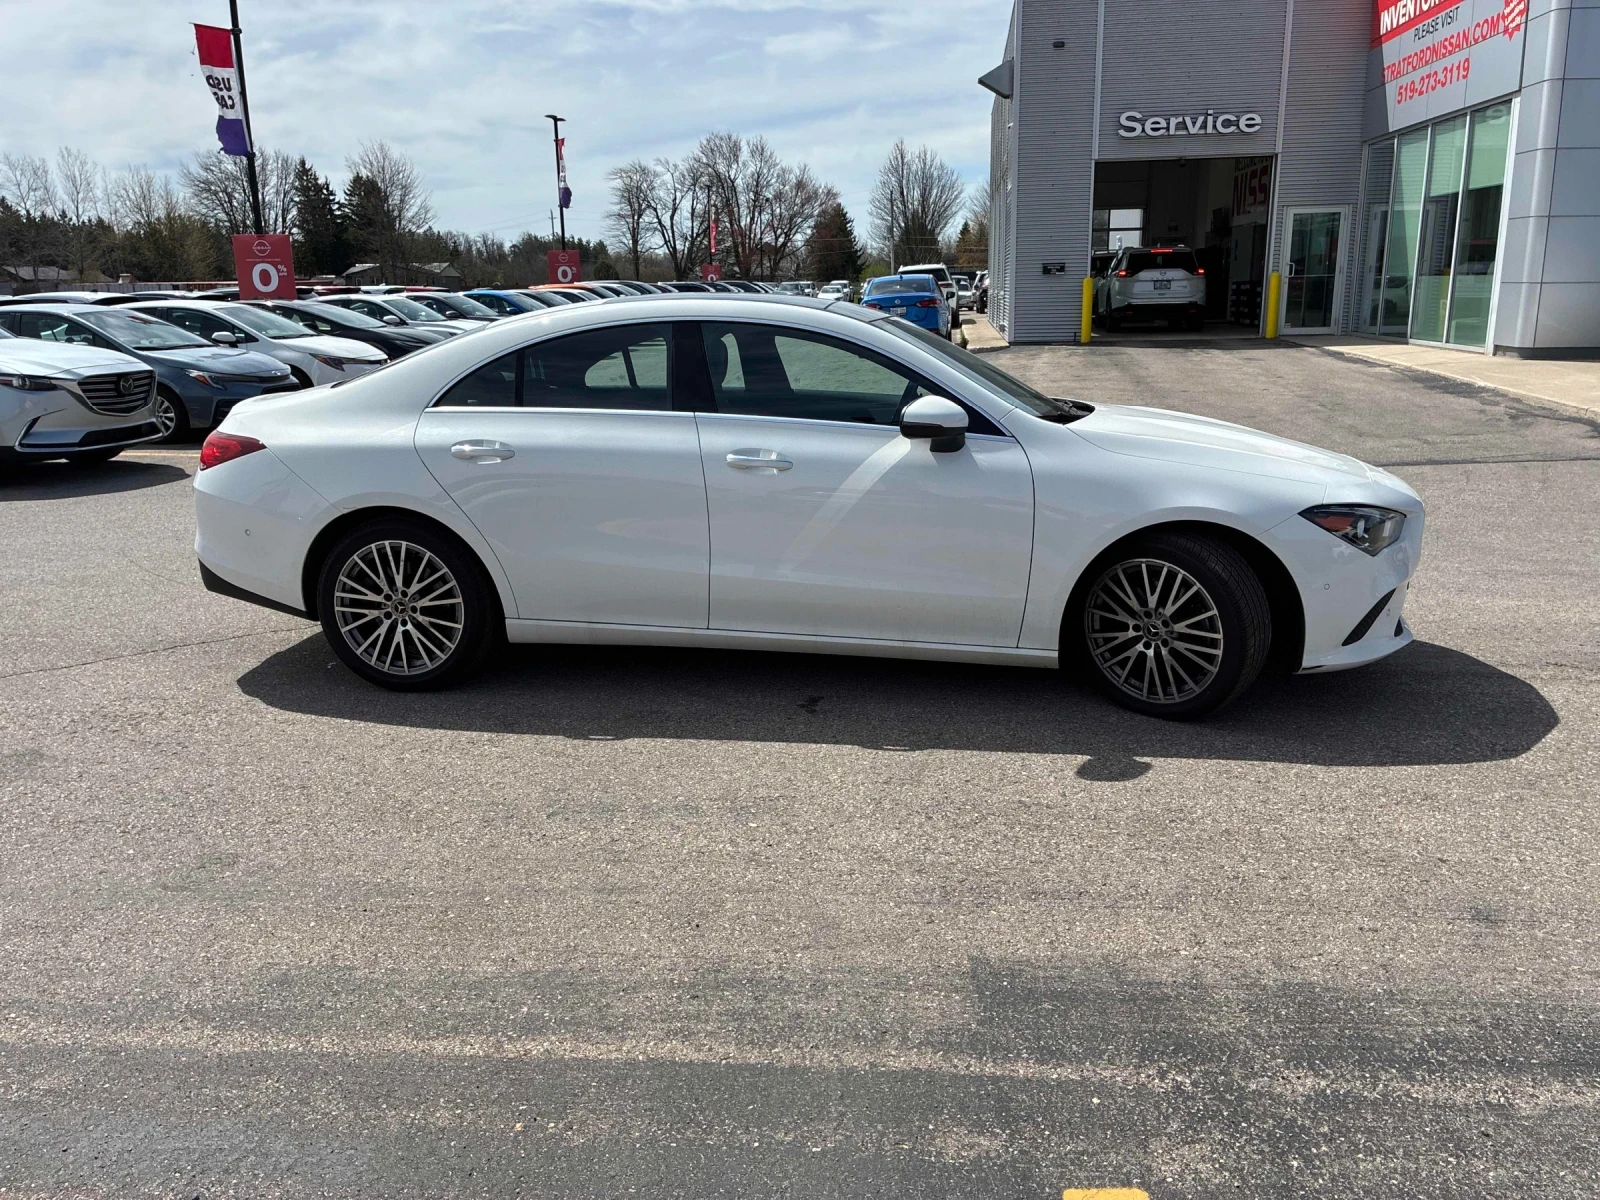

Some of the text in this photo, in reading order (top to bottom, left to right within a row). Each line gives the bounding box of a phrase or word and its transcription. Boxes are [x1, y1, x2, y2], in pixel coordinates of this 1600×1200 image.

[1413, 6, 1460, 42] PLEASE VISIT
[1382, 12, 1501, 83] STRATFORDNISSAN.COM
[1397, 57, 1470, 105] 519-273-3119
[1118, 109, 1262, 138] Service
